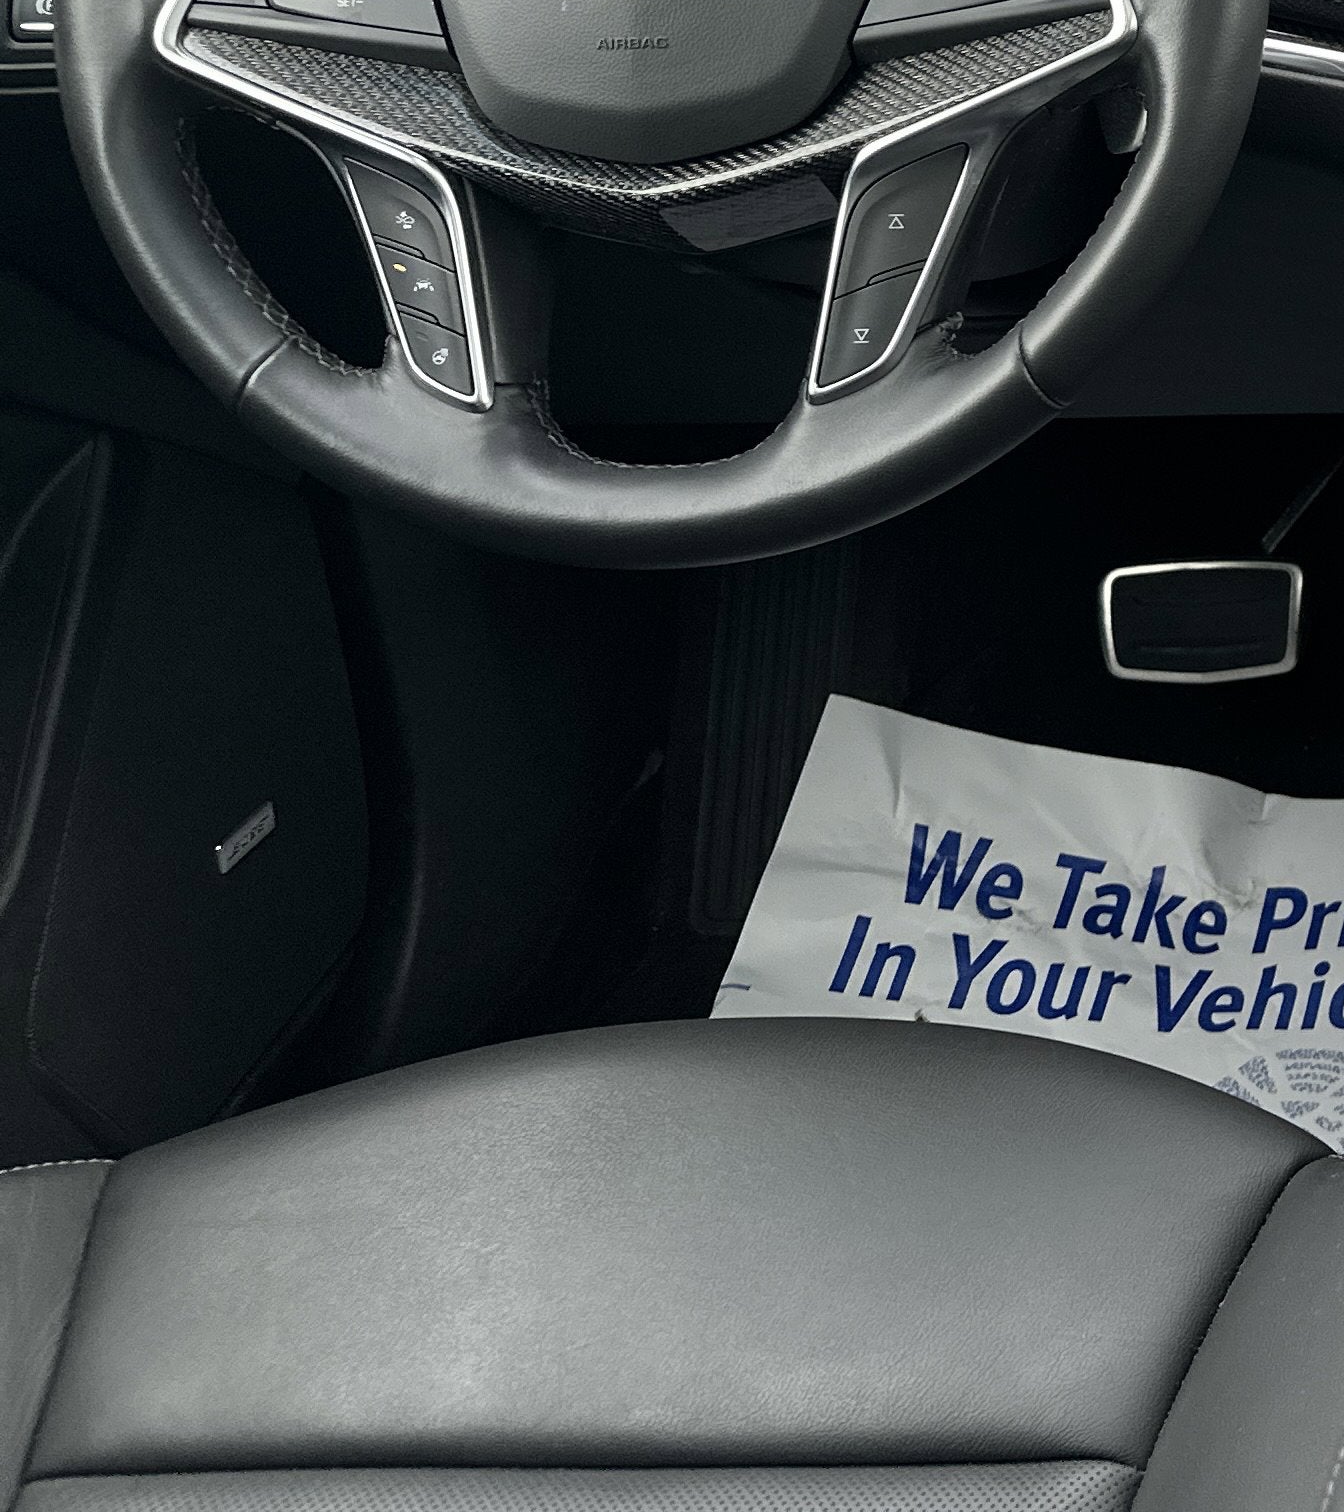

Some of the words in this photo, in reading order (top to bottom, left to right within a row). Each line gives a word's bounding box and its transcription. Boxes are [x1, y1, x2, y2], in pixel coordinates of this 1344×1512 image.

[597, 36, 670, 50] AIRBAG
[904, 823, 1023, 919] We
[1052, 852, 1228, 954] Take
[828, 915, 916, 1001] In
[947, 933, 1131, 1021] Your
